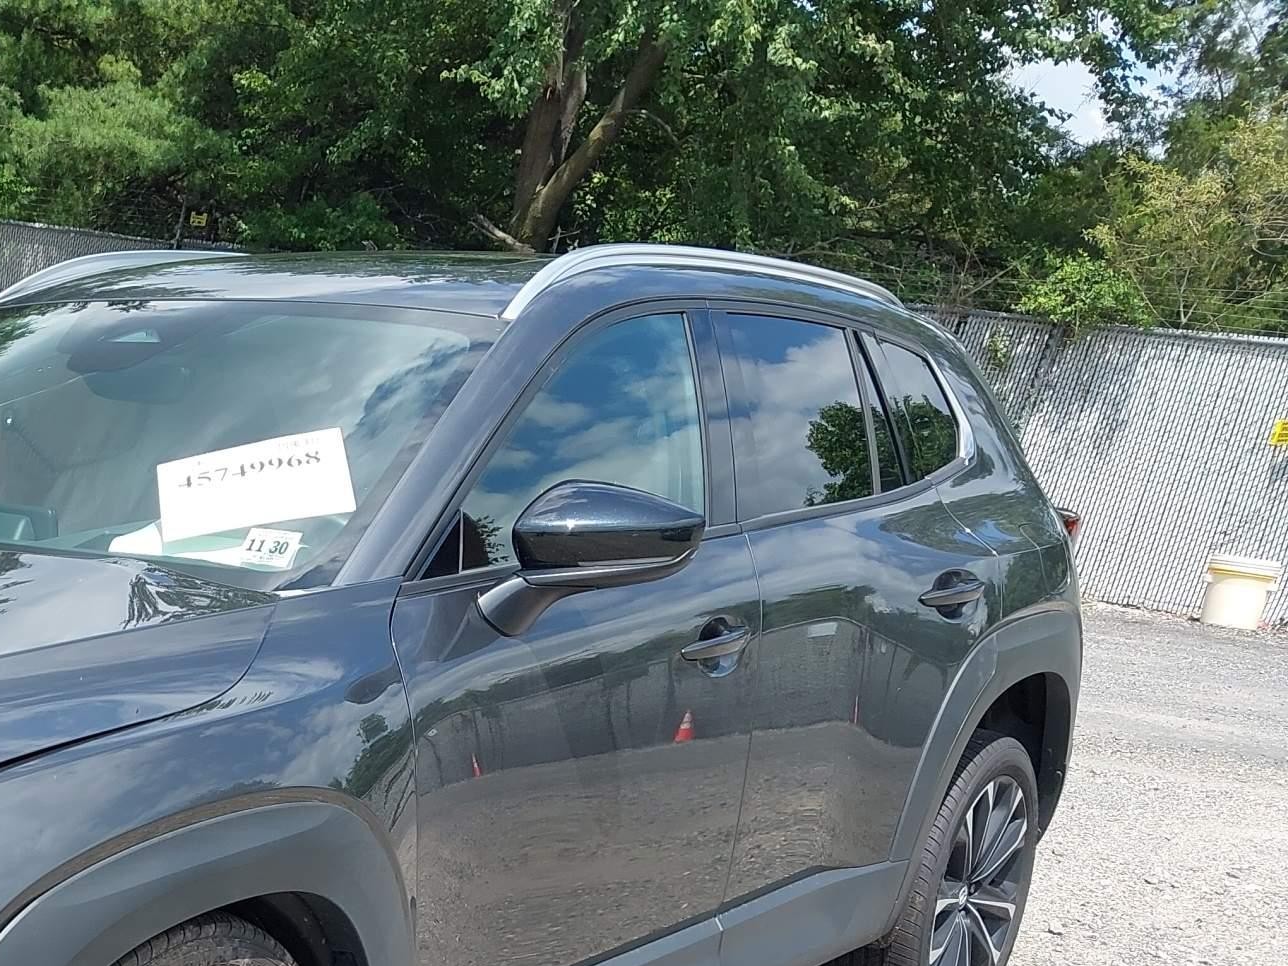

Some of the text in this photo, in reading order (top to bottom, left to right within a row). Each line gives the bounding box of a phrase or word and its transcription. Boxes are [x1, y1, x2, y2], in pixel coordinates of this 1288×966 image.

[178, 450, 321, 488] 45749968
[245, 538, 289, 555] 11 30
